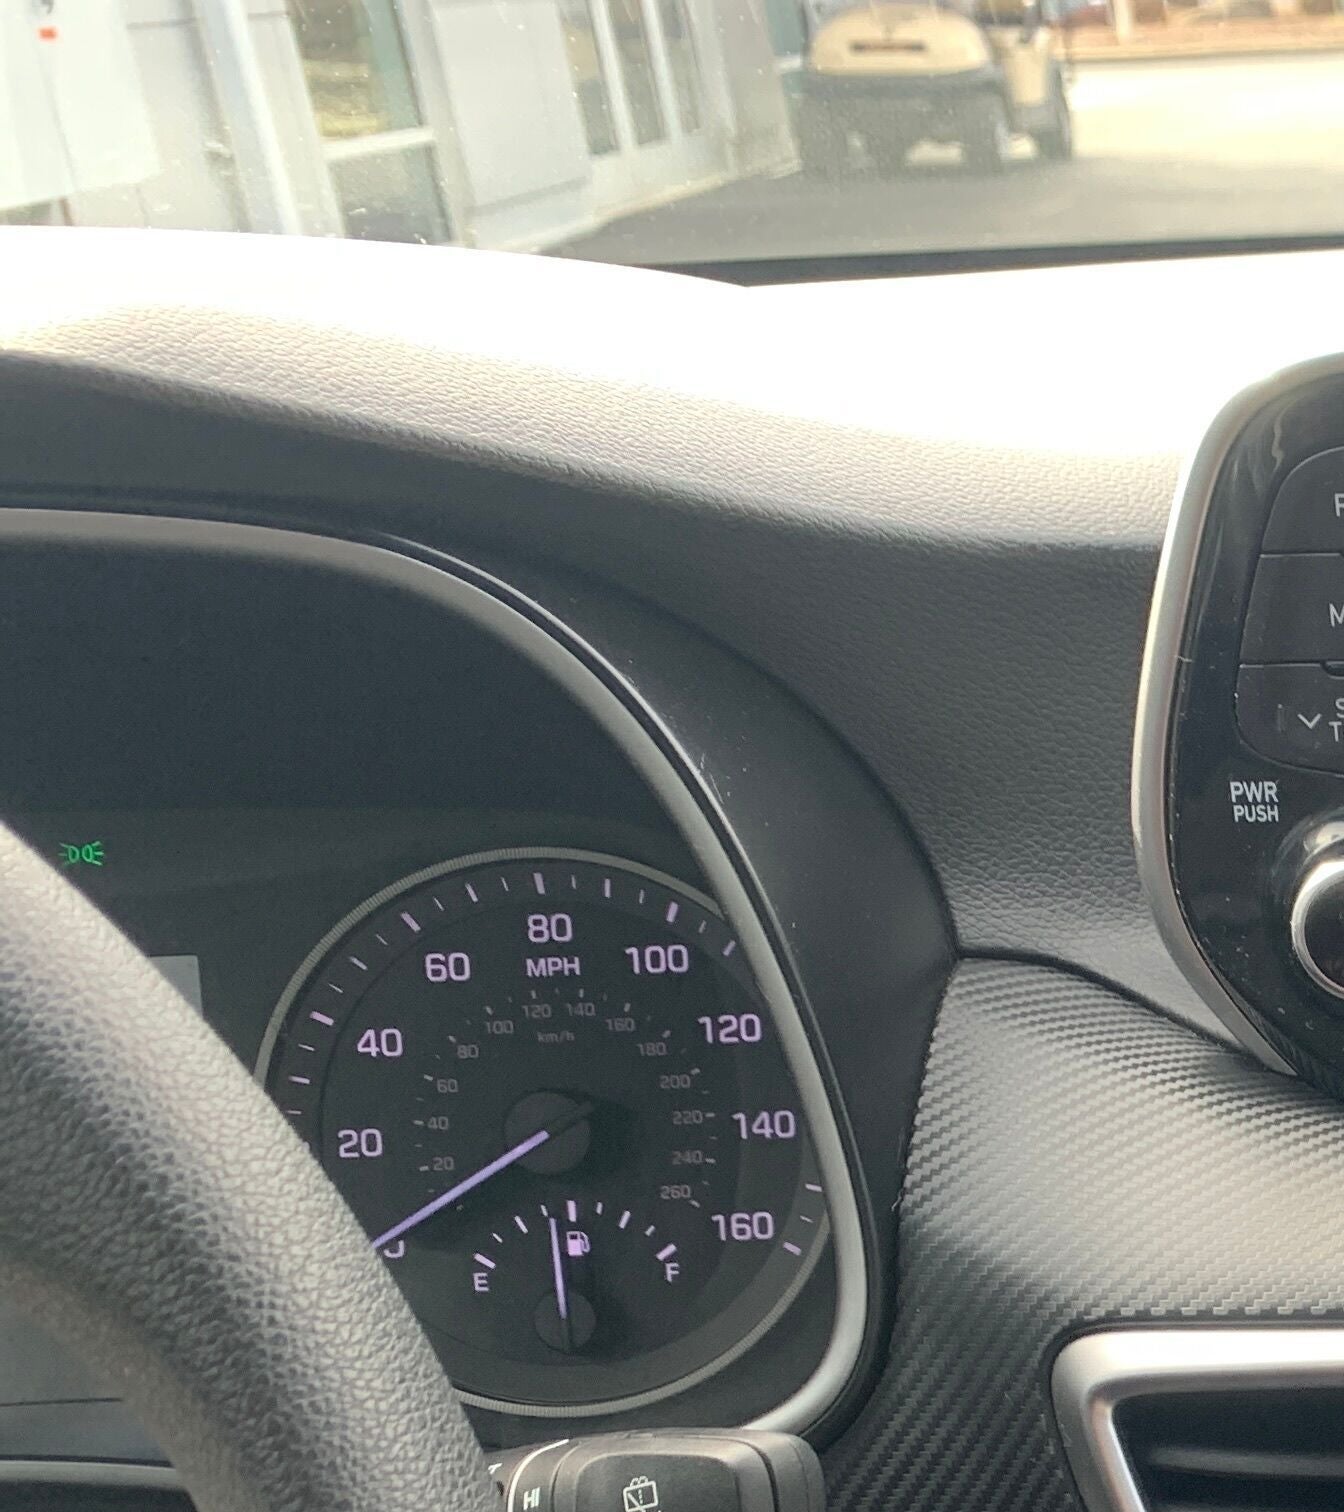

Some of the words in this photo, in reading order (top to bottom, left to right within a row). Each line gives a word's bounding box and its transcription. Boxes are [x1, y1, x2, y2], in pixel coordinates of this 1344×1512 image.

[1230, 780, 1279, 804] PWR
[1233, 804, 1280, 824] PUSH
[527, 913, 573, 943] 80
[424, 952, 471, 982] 60
[525, 956, 581, 977] MPH
[625, 944, 689, 975] 100
[522, 1004, 552, 1019] 120
[566, 1002, 596, 1017] 140
[485, 1020, 514, 1035] 100
[605, 1017, 636, 1032] 160
[698, 1013, 762, 1044] 120
[356, 1028, 403, 1057] 40
[537, 1031, 575, 1043] km/h
[457, 1045, 479, 1059] 80
[637, 1042, 667, 1057] 180
[437, 1079, 458, 1093] 60
[660, 1075, 691, 1089] 200
[427, 1116, 449, 1130] 40
[672, 1110, 703, 1125] 220
[732, 1110, 796, 1140] 140
[337, 1128, 383, 1158] 20
[433, 1157, 454, 1171] 20
[672, 1150, 703, 1165] 240
[660, 1185, 691, 1200] 260
[711, 1211, 774, 1241] 160
[664, 1262, 680, 1283] F
[473, 1272, 489, 1292] E
[523, 1487, 541, 1511] HI
